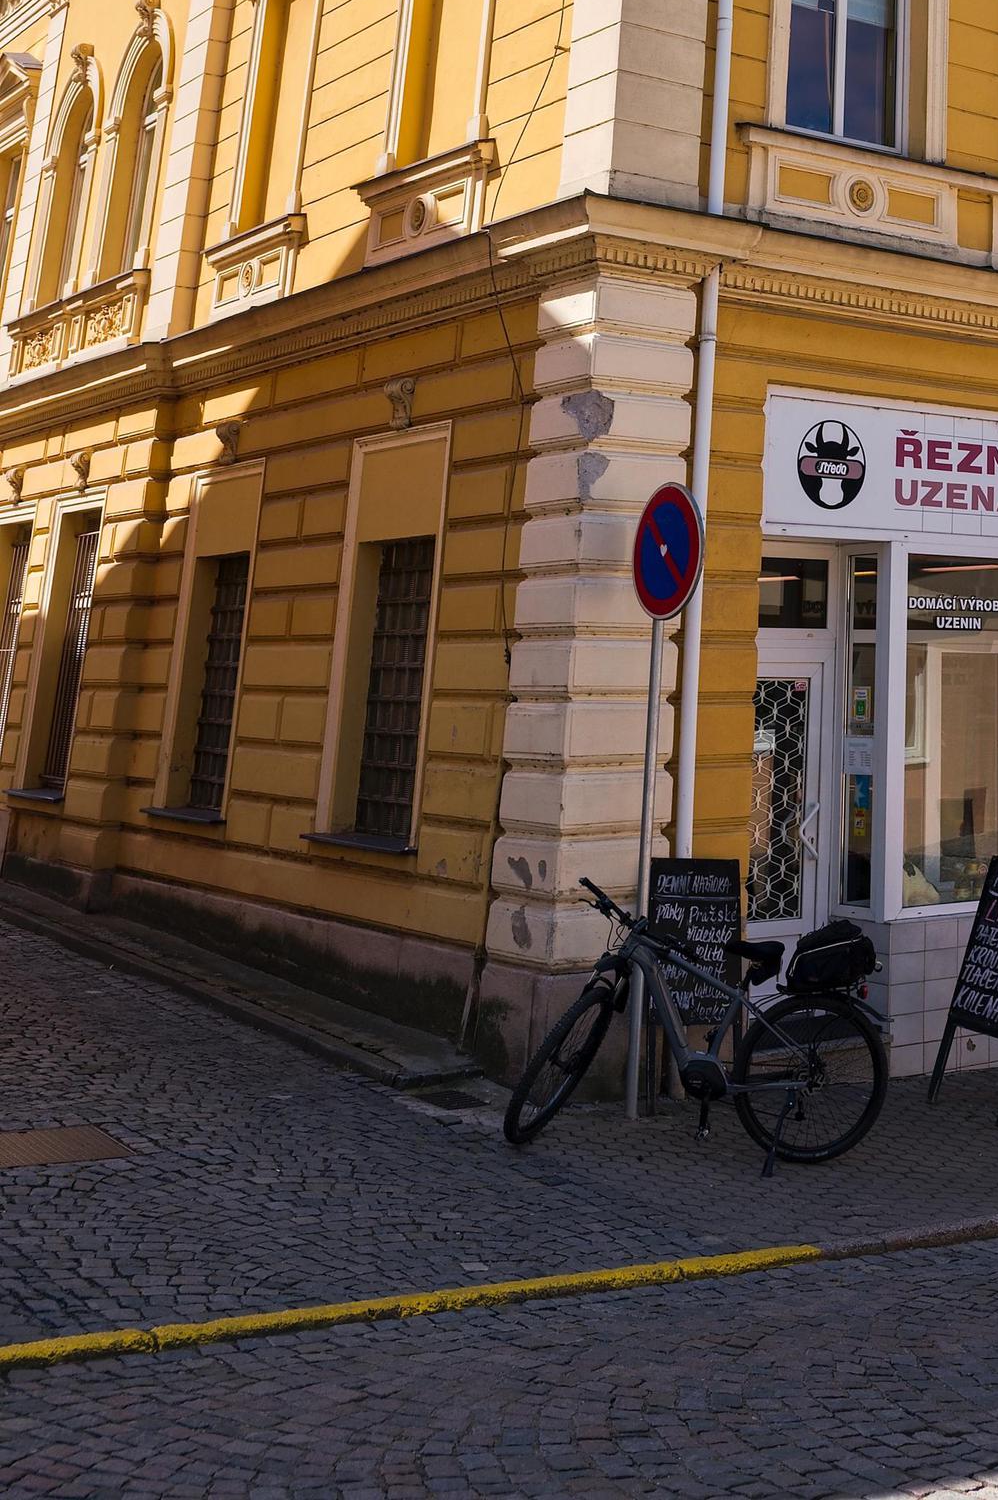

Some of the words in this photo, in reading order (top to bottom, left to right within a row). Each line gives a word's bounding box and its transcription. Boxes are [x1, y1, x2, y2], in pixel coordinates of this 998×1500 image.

[909, 595, 957, 611] DOMÁCÍ
[936, 617, 982, 630] UZENIN
[657, 871, 693, 894] DENNÍ
[689, 902, 738, 923] Pražské
